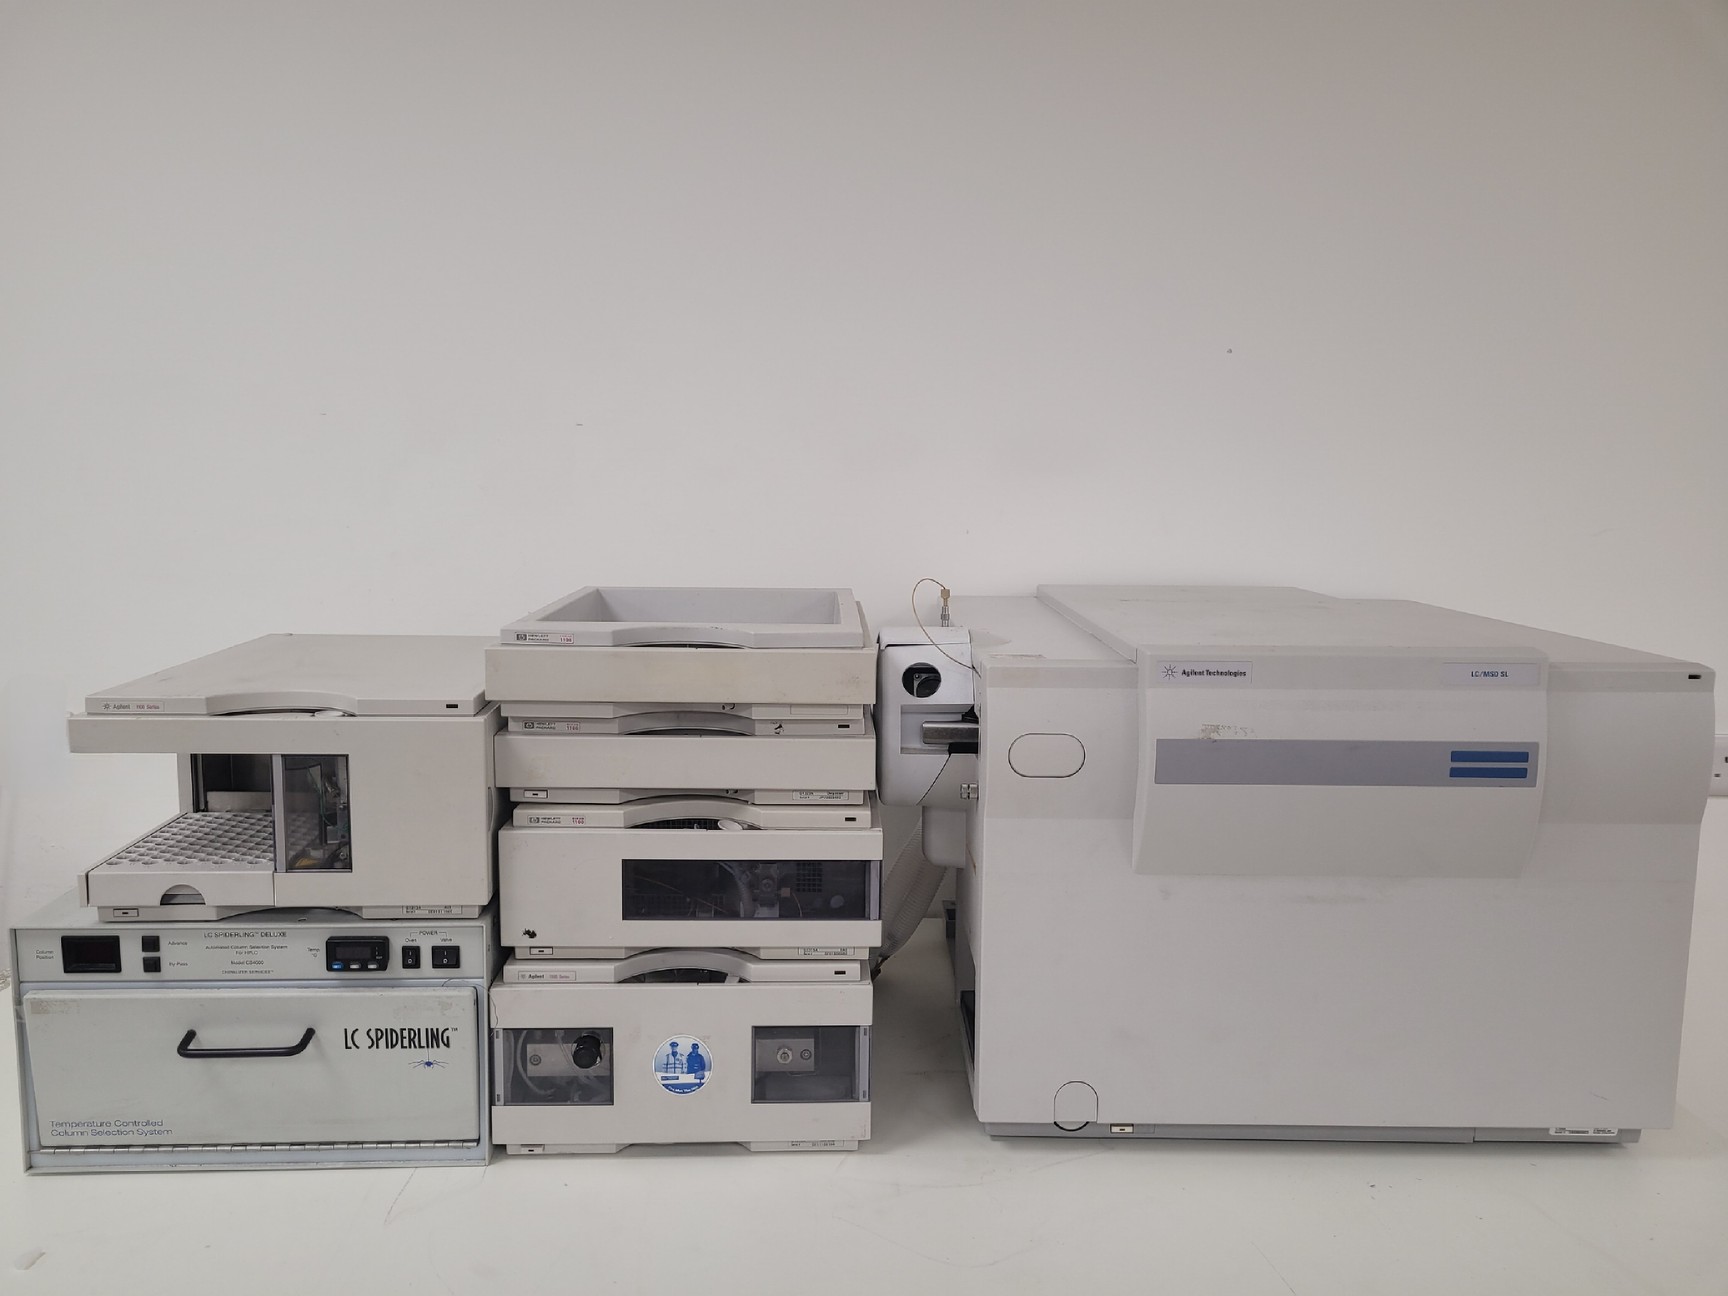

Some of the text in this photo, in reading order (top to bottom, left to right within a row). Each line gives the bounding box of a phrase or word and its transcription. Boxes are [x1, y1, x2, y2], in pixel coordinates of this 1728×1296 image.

[1182, 669, 1246, 677] Agilent Technologies
[344, 1028, 360, 1049] LC
[49, 1120, 112, 1128] Temperature
